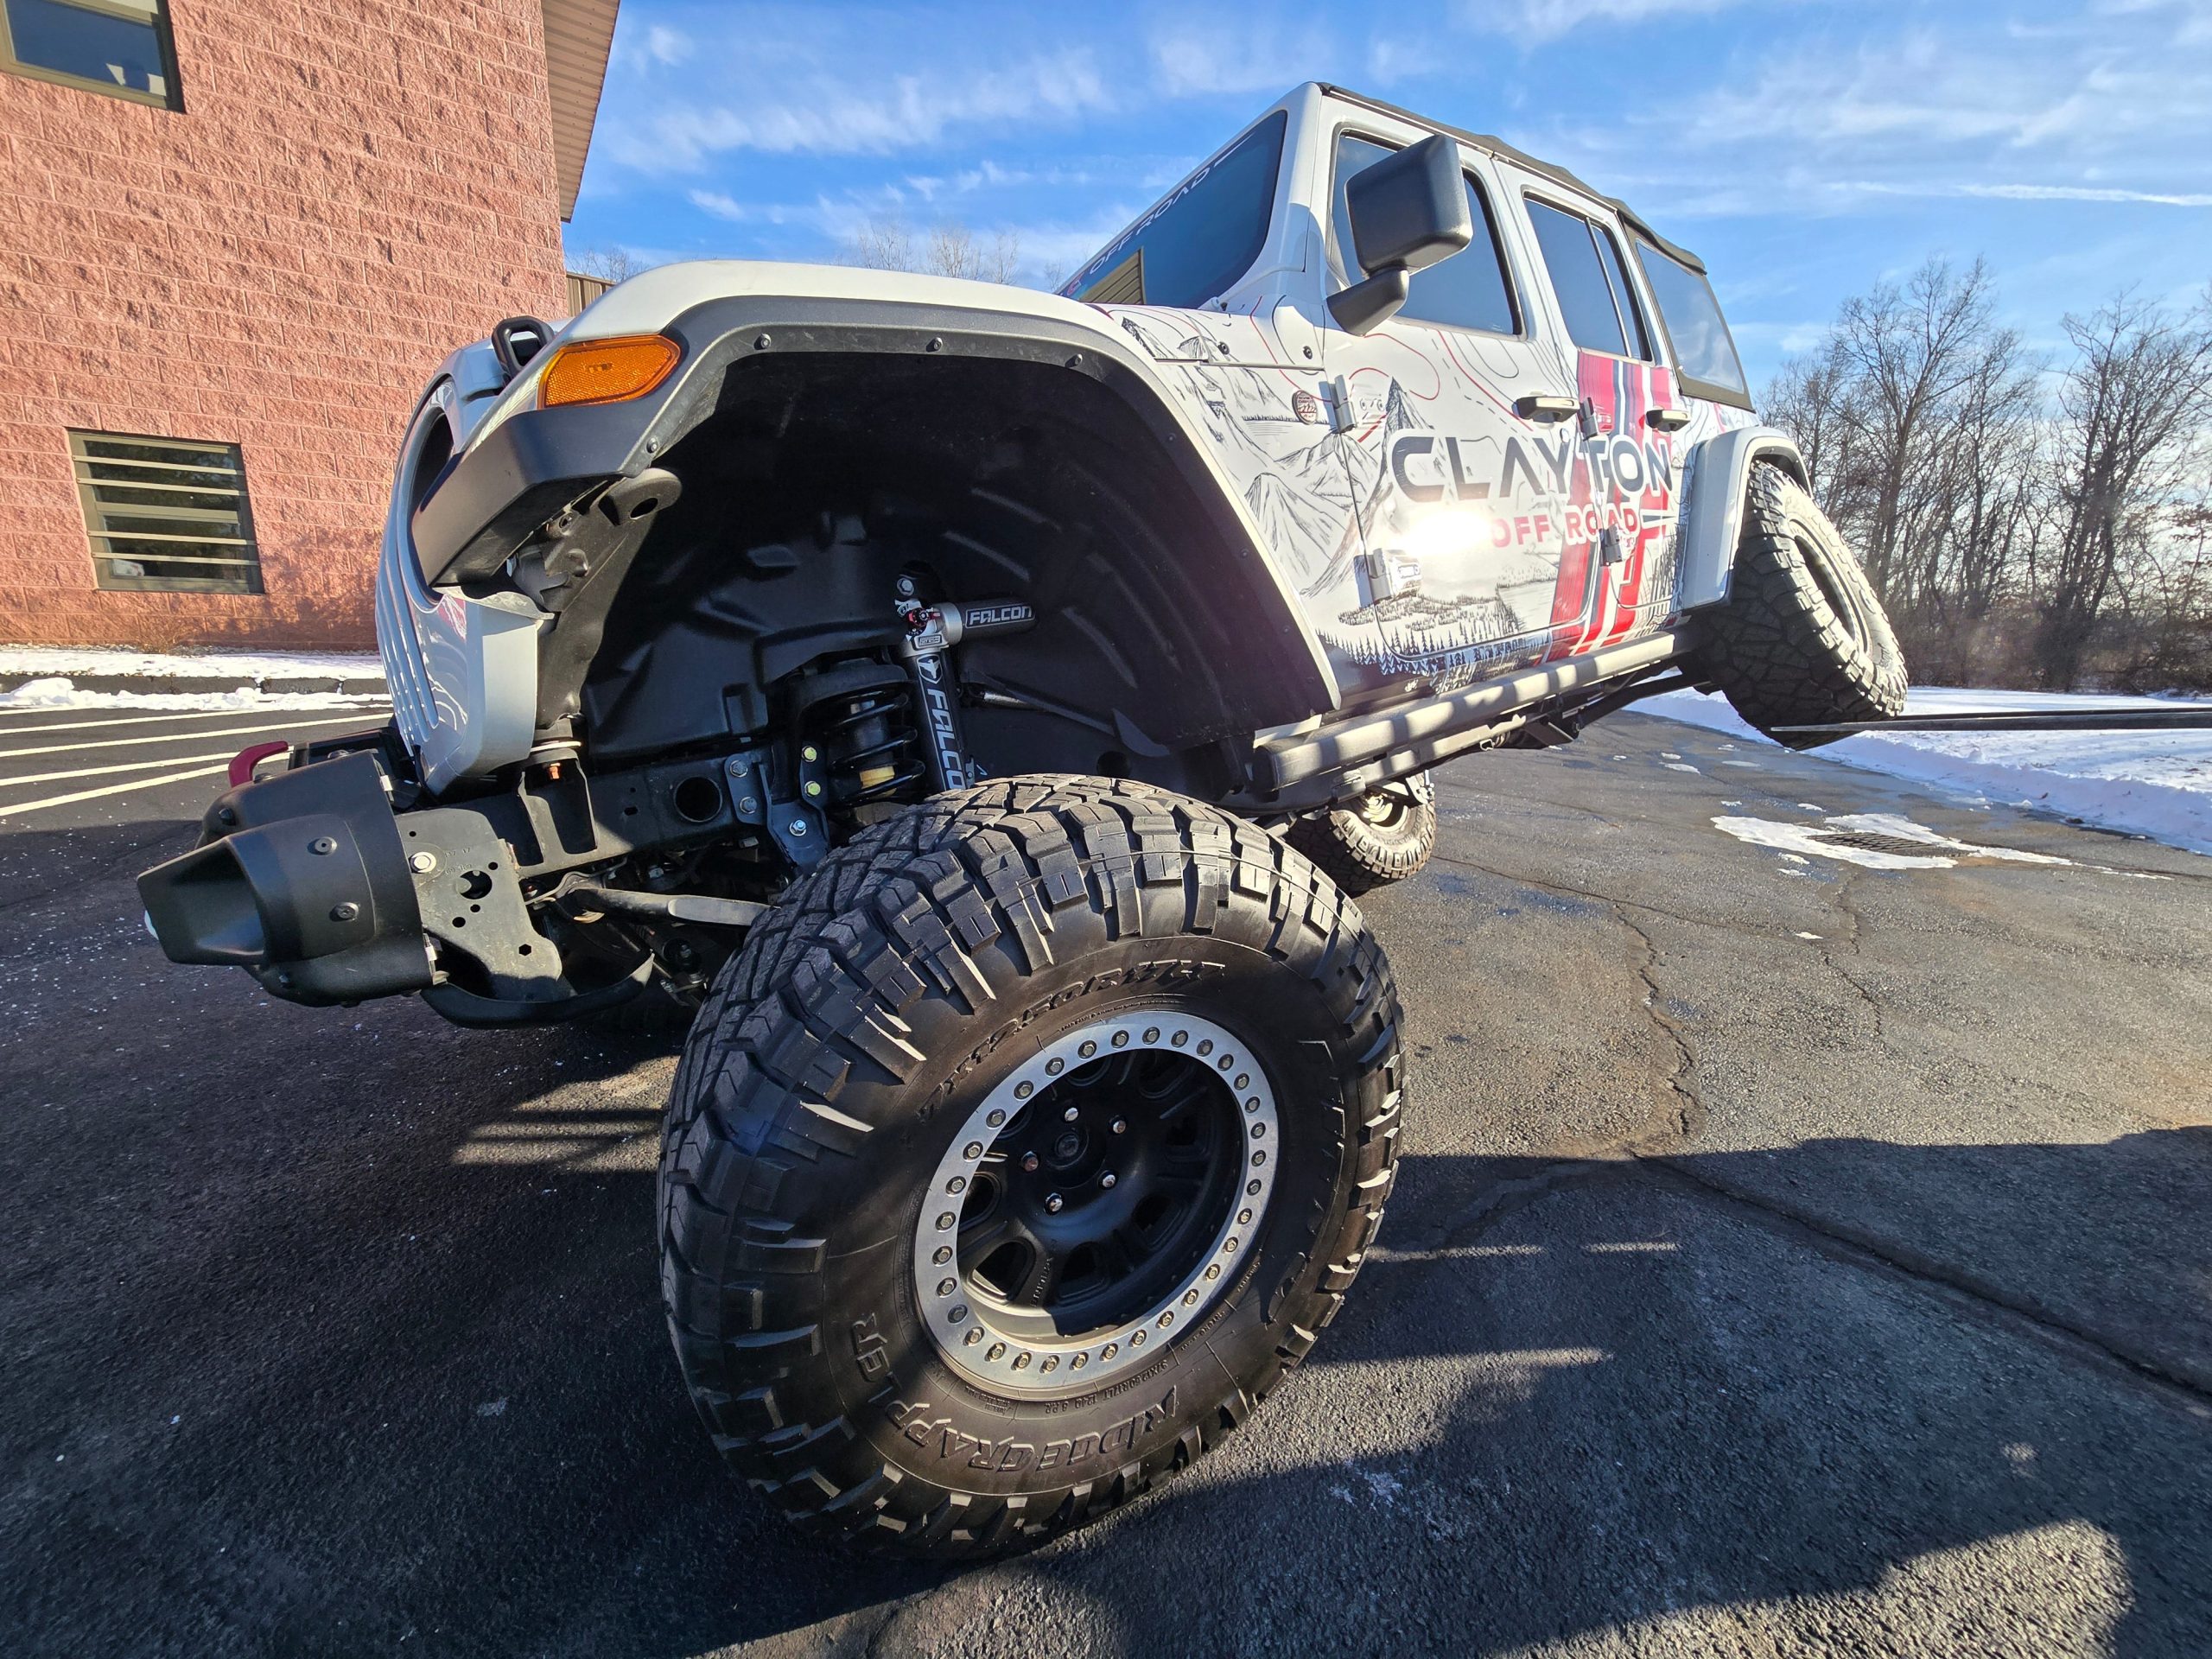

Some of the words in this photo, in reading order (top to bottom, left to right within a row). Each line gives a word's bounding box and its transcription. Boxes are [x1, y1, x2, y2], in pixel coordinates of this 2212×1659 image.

[1089, 231, 1134, 275] OFF
[1135, 166, 1211, 236] ROAD
[1392, 435, 1673, 503] CLAYTON
[1492, 514, 1551, 548] OFF
[969, 607, 1032, 626] FALCON
[928, 689, 965, 790] FALCO
[1039, 1384, 1178, 1470] RIDGE
